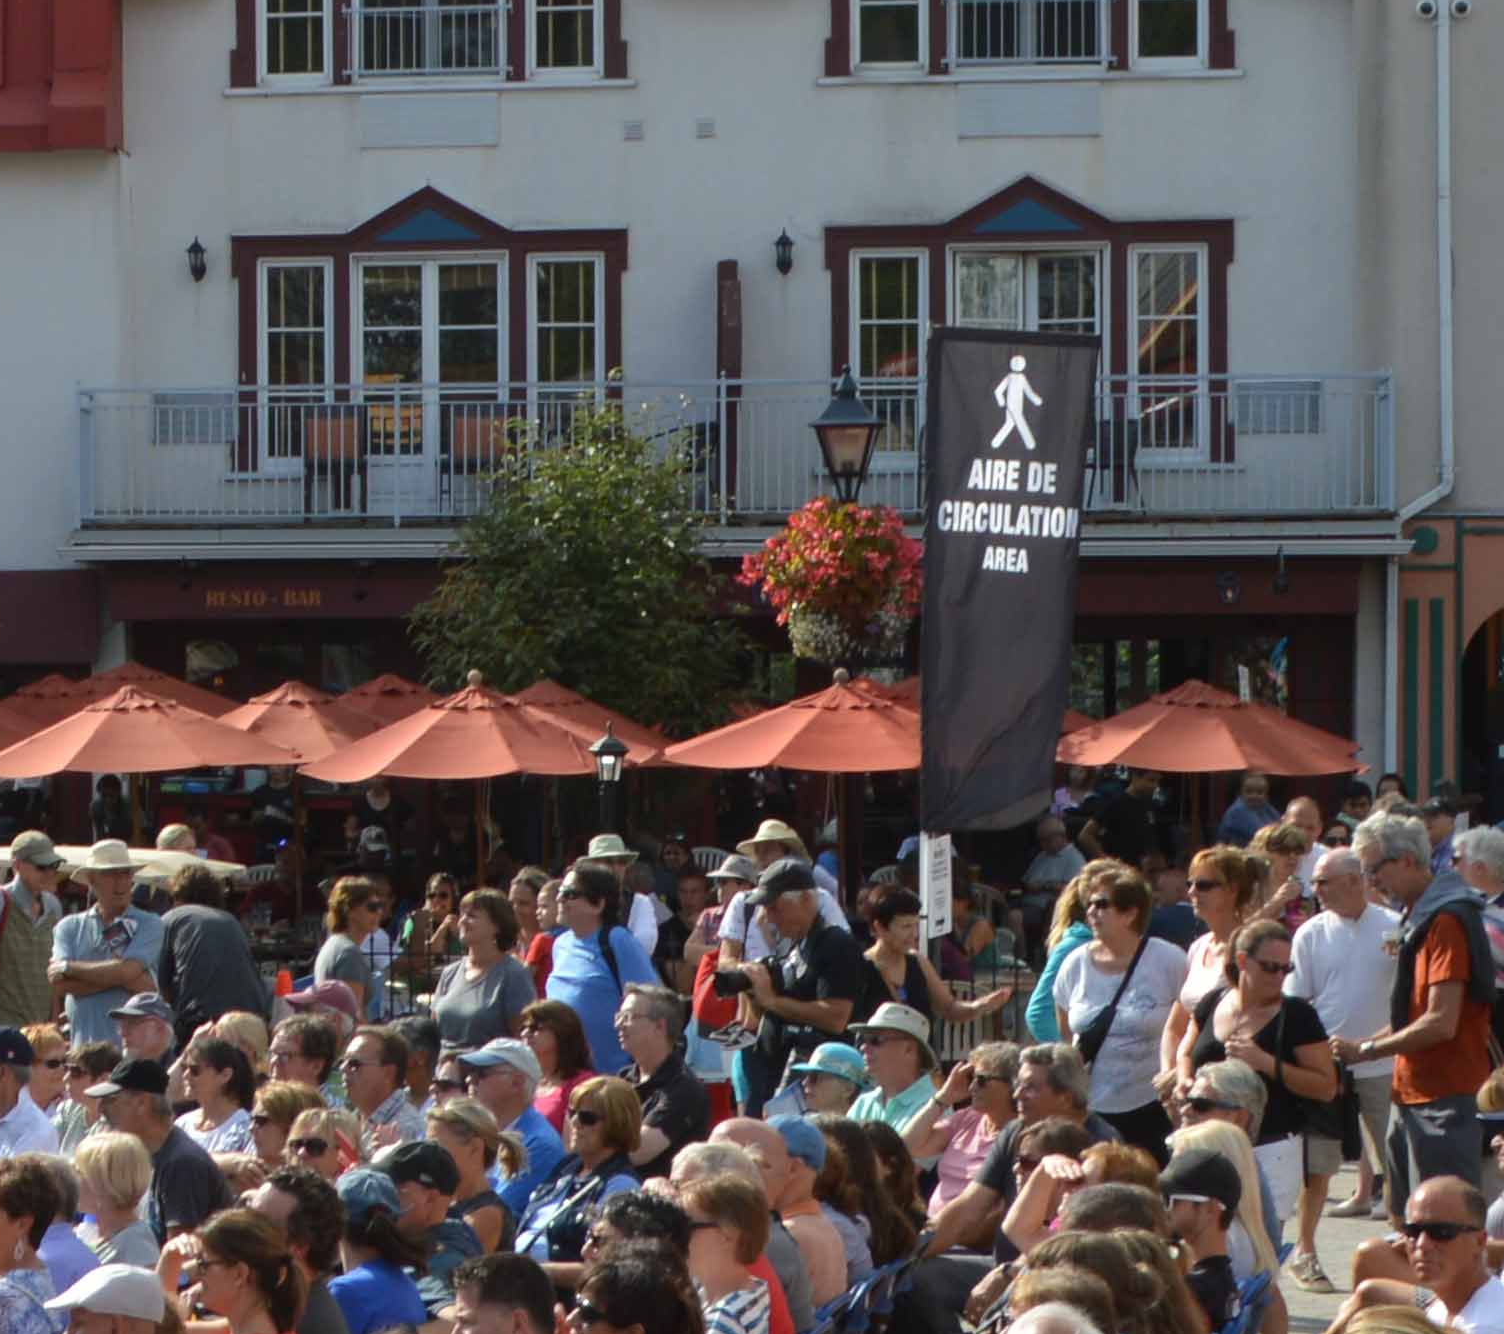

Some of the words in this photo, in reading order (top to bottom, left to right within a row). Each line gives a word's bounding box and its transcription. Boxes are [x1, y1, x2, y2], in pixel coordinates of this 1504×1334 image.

[967, 458, 1020, 491] AIRE
[1026, 461, 1058, 494] DE
[937, 500, 1079, 539] CIRCULATION
[981, 544, 1029, 574] AREA
[206, 589, 266, 608] RESTO
[283, 589, 321, 608] BAR
